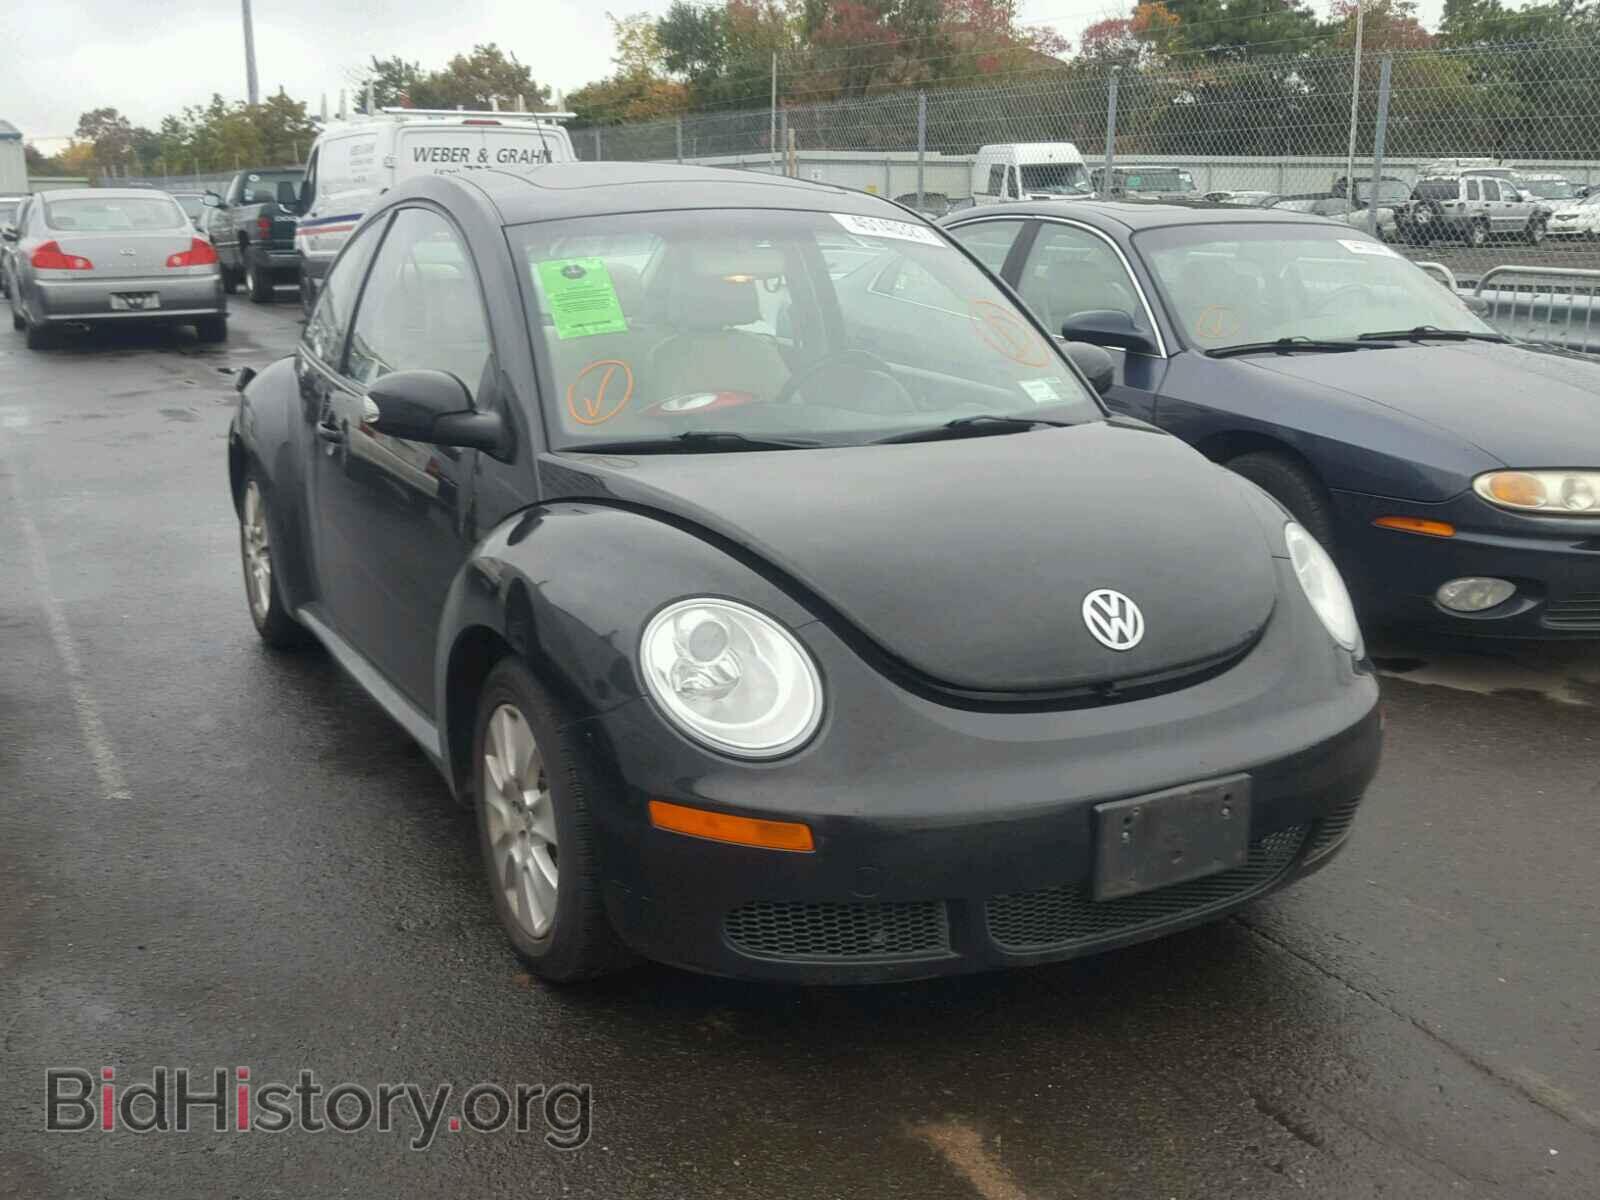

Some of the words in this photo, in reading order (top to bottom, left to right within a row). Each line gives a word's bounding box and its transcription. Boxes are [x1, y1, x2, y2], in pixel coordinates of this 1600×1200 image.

[413, 147, 470, 163] WEBER
[477, 148, 488, 163] &
[496, 148, 553, 164] GRAHN
